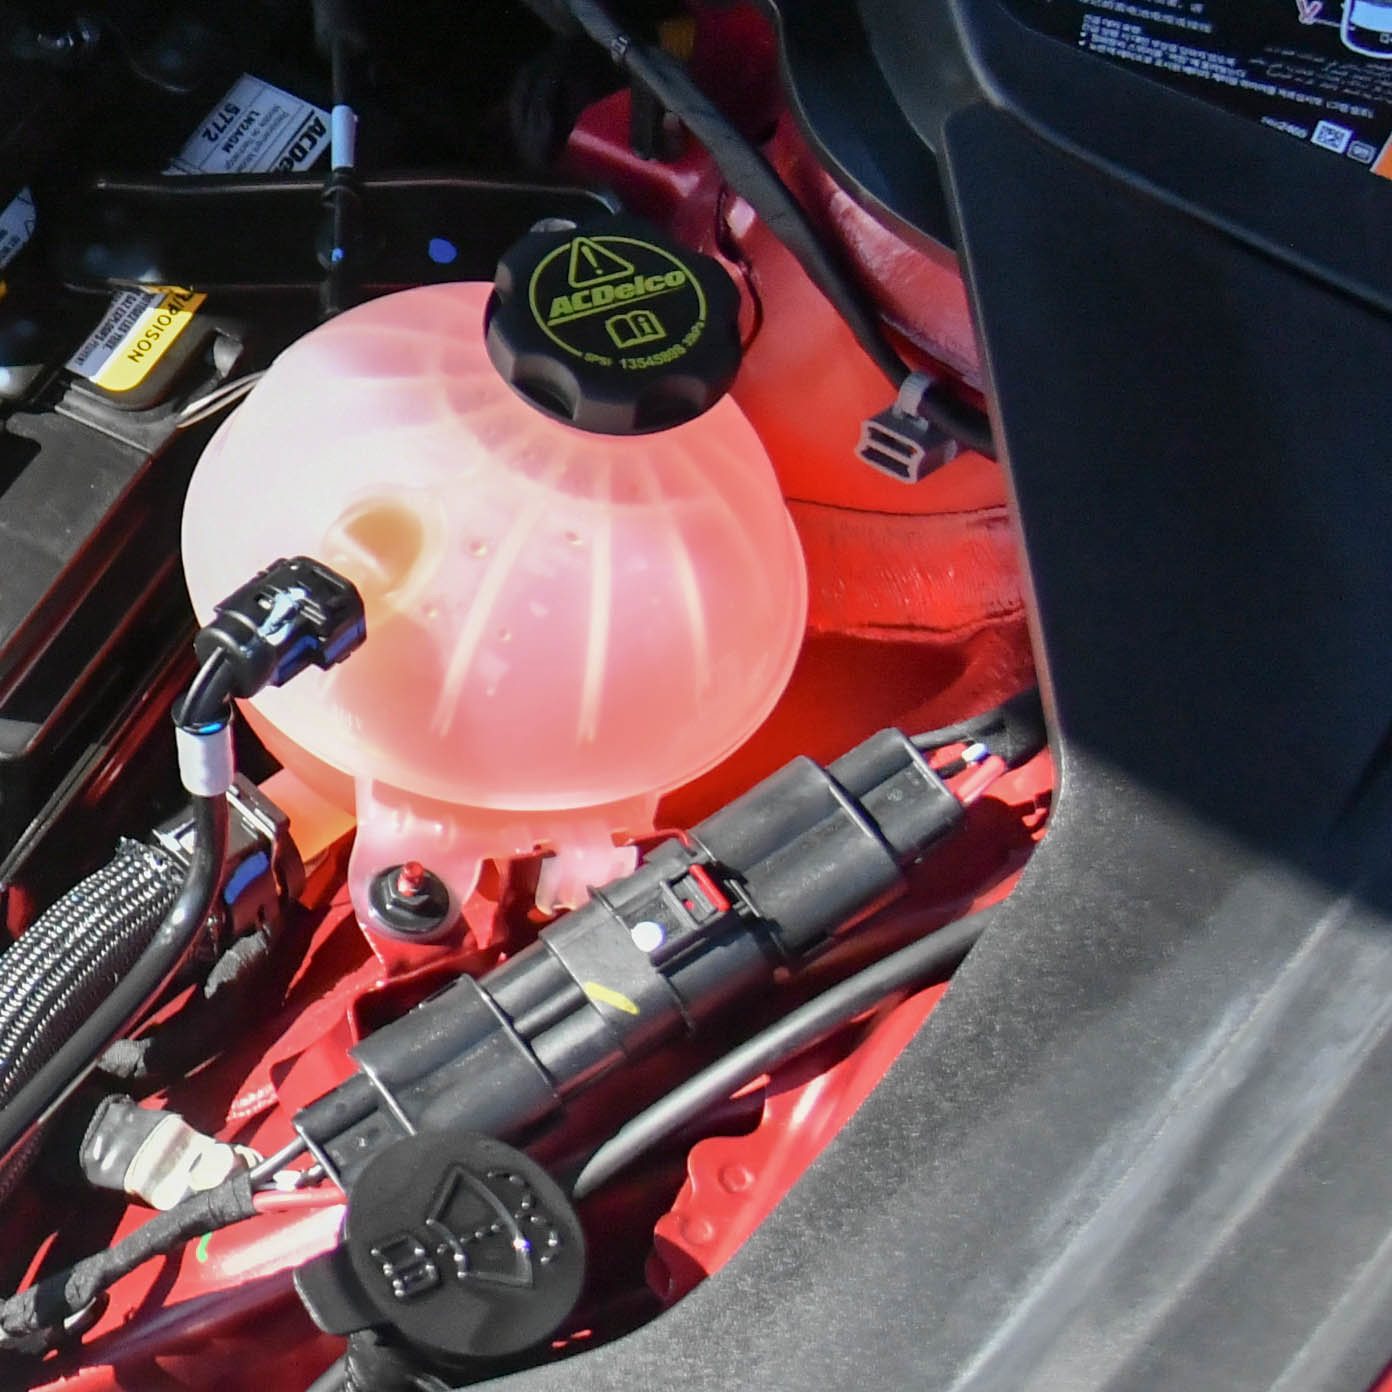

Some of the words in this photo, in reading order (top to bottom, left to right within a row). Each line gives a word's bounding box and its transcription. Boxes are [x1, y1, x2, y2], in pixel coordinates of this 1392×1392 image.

[199, 100, 242, 145] 5772
[220, 108, 260, 155] LN2AGM
[269, 114, 328, 175] ACDe
[549, 270, 686, 319] ACDelco
